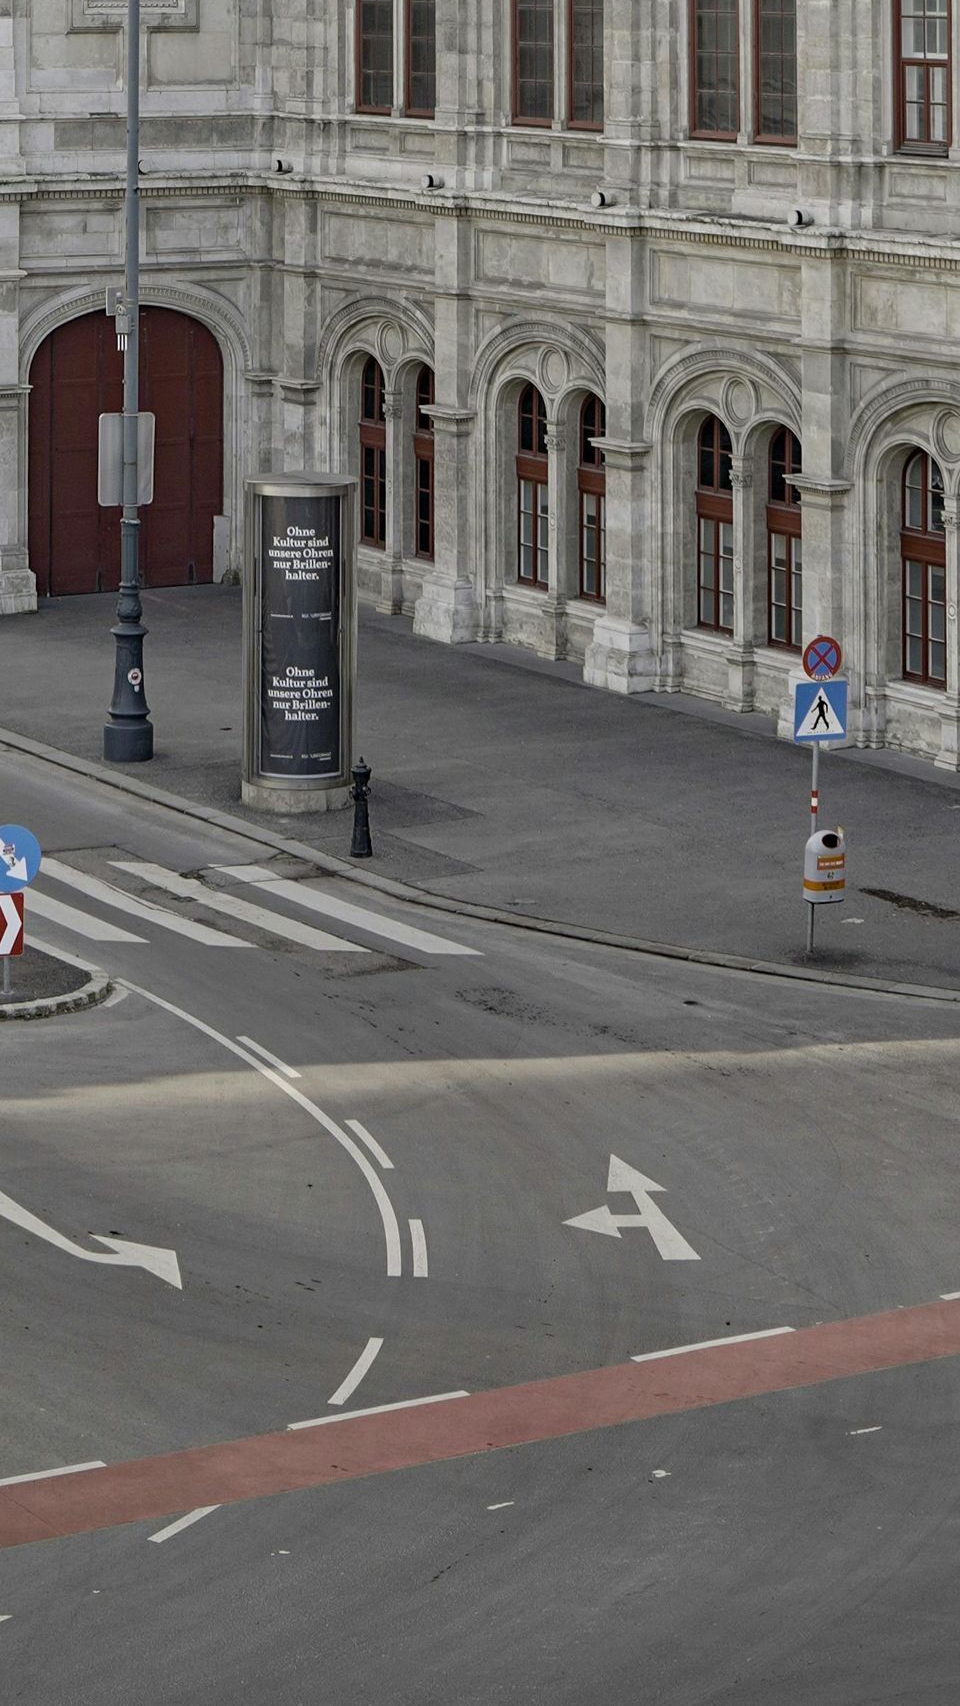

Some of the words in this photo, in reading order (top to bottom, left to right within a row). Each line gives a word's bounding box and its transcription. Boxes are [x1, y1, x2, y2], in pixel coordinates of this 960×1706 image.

[287, 526, 315, 536] Ohne
[273, 536, 306, 547] Kultur
[308, 536, 329, 547] sind
[269, 549, 302, 558] unsere
[303, 548, 333, 558] Ohren
[273, 561, 291, 569] nur
[293, 559, 331, 569] Brillen-
[285, 570, 319, 580] halter.
[286, 666, 314, 676] Ohne
[272, 676, 305, 687] Kultur
[307, 676, 328, 687] sind
[268, 689, 301, 698] unsere
[302, 688, 332, 698] Ohren
[272, 701, 290, 709] nur
[292, 699, 330, 709] Brillen-
[284, 710, 318, 720] halter.
